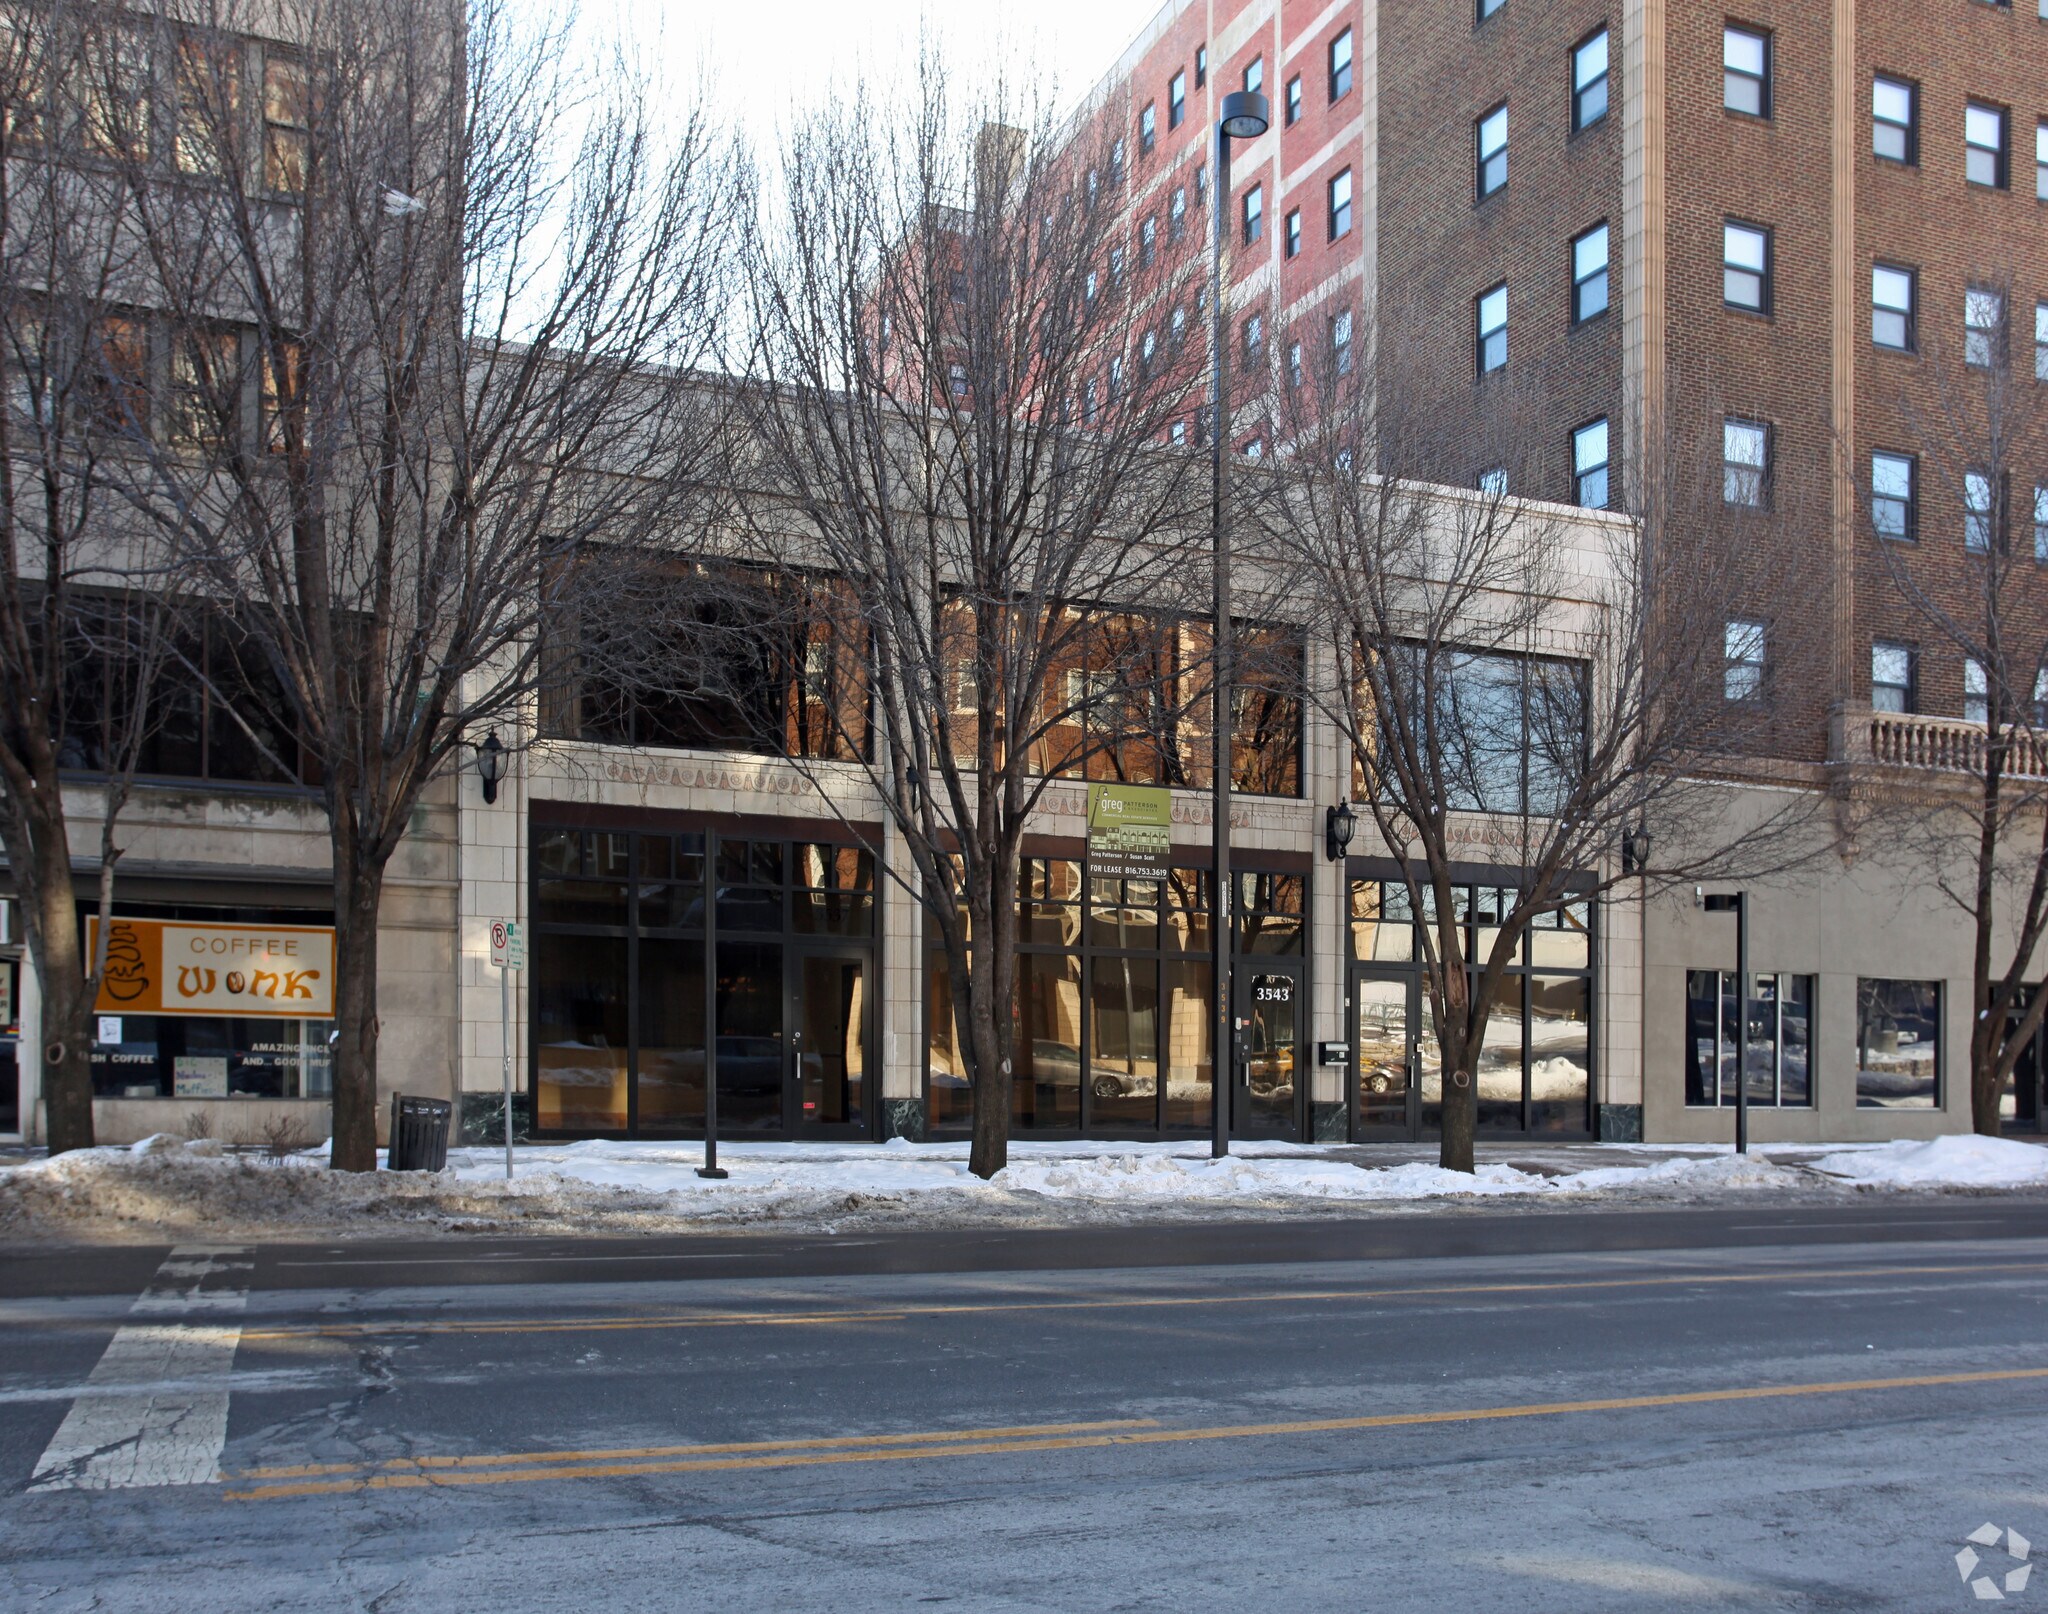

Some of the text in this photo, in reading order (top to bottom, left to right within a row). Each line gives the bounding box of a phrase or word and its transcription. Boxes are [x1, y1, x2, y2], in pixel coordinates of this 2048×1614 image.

[1101, 799, 1158, 813] greg PATTERSON
[1102, 851, 1122, 859] Patterson
[1090, 864, 1167, 877] FOR LEASE 816.753.3619
[190, 937, 298, 956] COFFEE
[1256, 987, 1289, 1001] 3543
[251, 1042, 301, 1053] AMAZING
[111, 1053, 155, 1064] COFFEE
